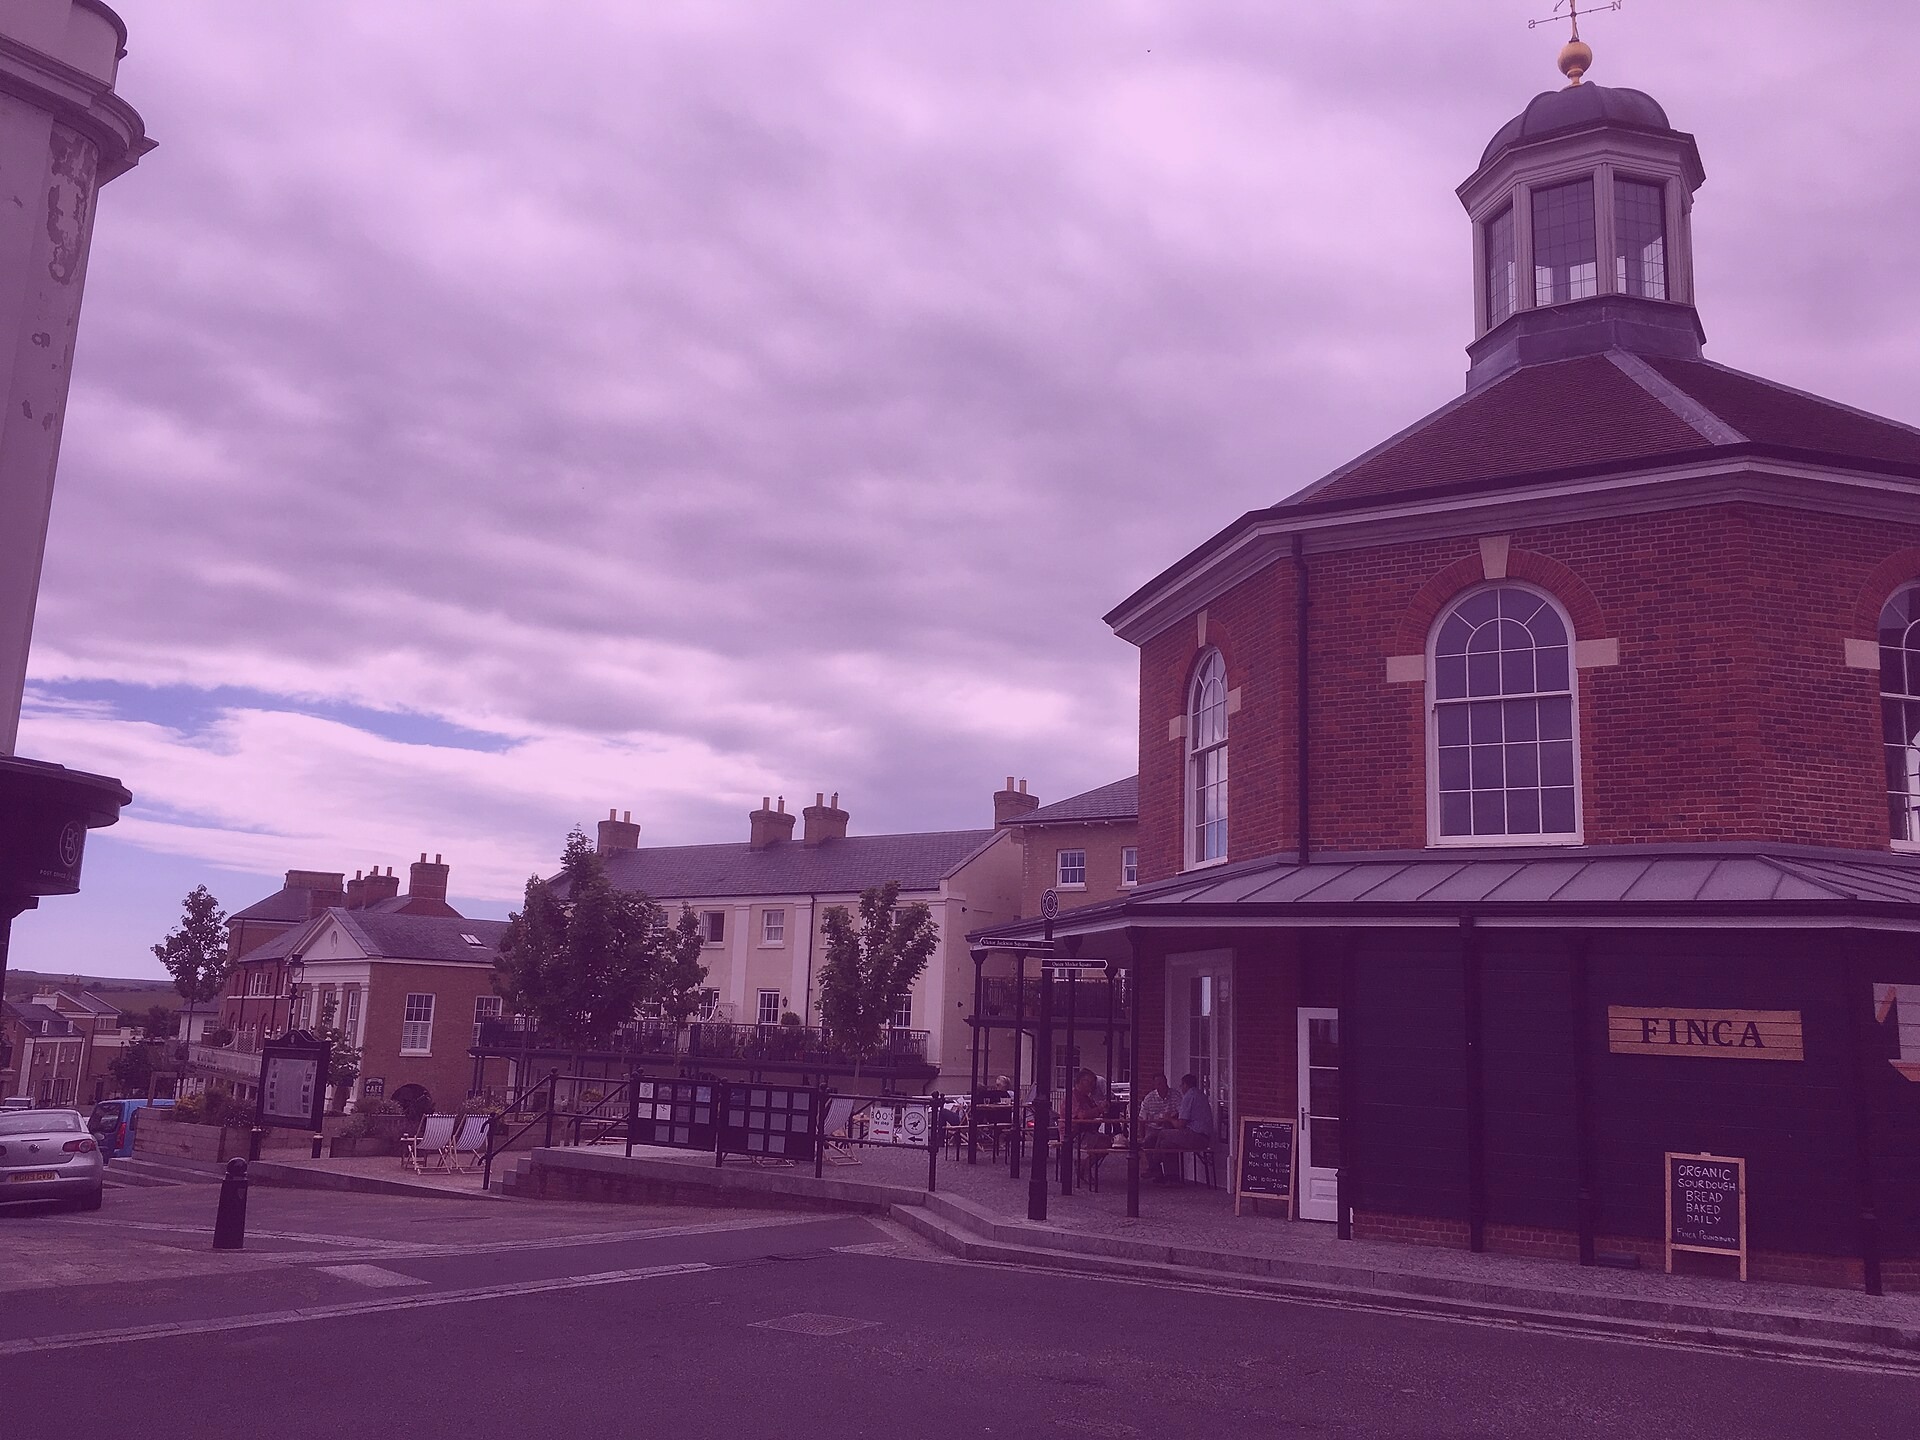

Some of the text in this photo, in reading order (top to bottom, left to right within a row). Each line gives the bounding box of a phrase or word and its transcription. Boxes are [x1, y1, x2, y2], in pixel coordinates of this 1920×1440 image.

[1640, 1017, 1765, 1048] FINCA
[1252, 1127, 1274, 1139] FINCA
[1262, 1152, 1278, 1160] OPEN
[1678, 1165, 1731, 1181] ORGANIC
[1678, 1178, 1736, 1191] SOURDOUGH
[1686, 1190, 1723, 1203] BREAD
[1686, 1202, 1721, 1215] BAKED
[1687, 1214, 1721, 1225] DAILY
